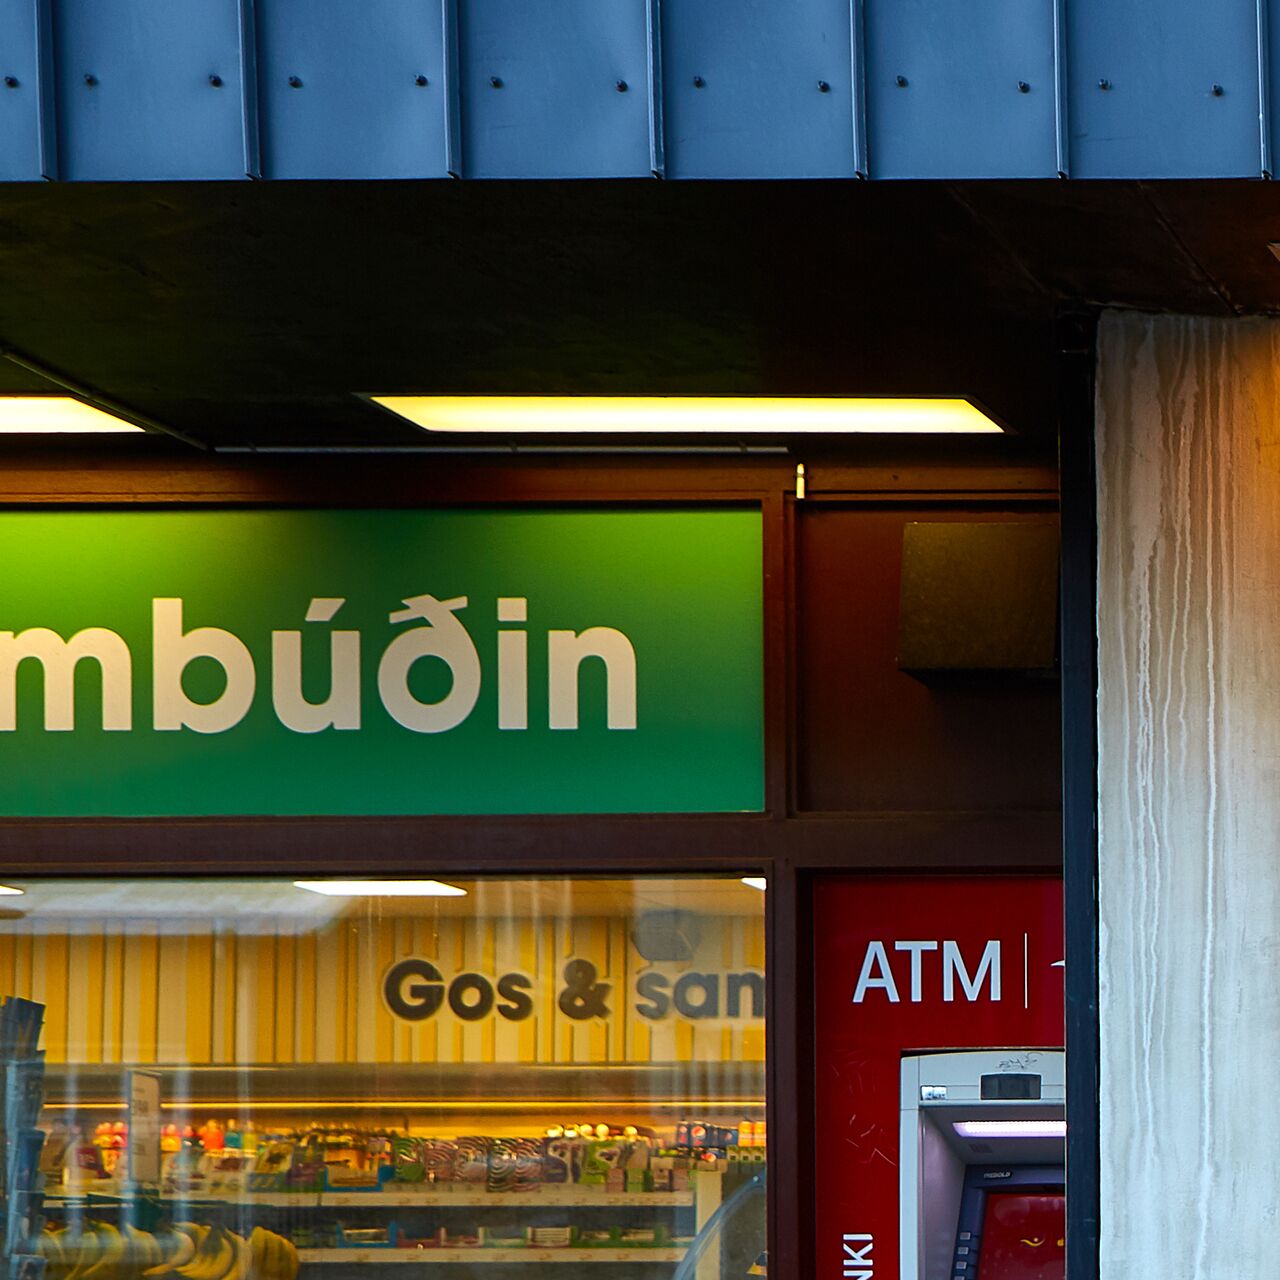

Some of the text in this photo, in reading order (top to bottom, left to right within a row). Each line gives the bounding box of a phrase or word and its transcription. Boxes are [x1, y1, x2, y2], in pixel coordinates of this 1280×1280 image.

[0, 594, 638, 734] mbúðin
[384, 958, 534, 1021] Gos
[558, 958, 613, 1021] &
[853, 940, 1002, 1003] ATM
